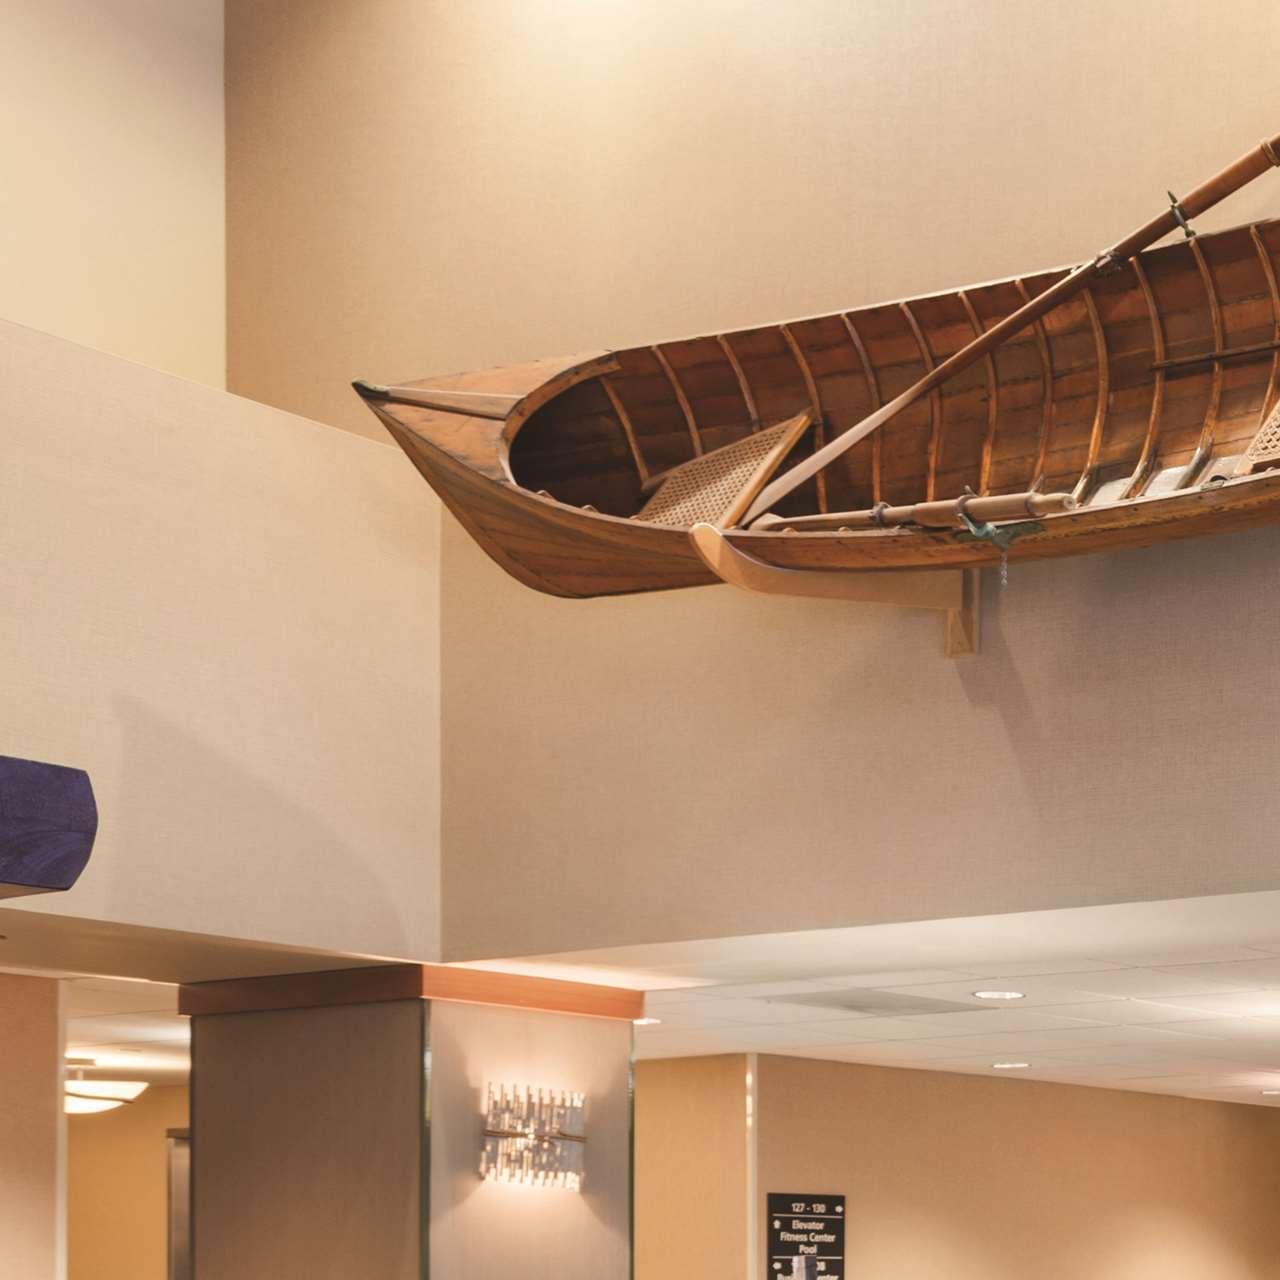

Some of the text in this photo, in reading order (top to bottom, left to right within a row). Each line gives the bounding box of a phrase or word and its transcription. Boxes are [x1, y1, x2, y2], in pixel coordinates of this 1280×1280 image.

[792, 1203, 806, 1213] 127
[792, 1219, 825, 1230] Elevator
[780, 1231, 836, 1243] Fitness Center
[799, 1244, 818, 1254] Pool
